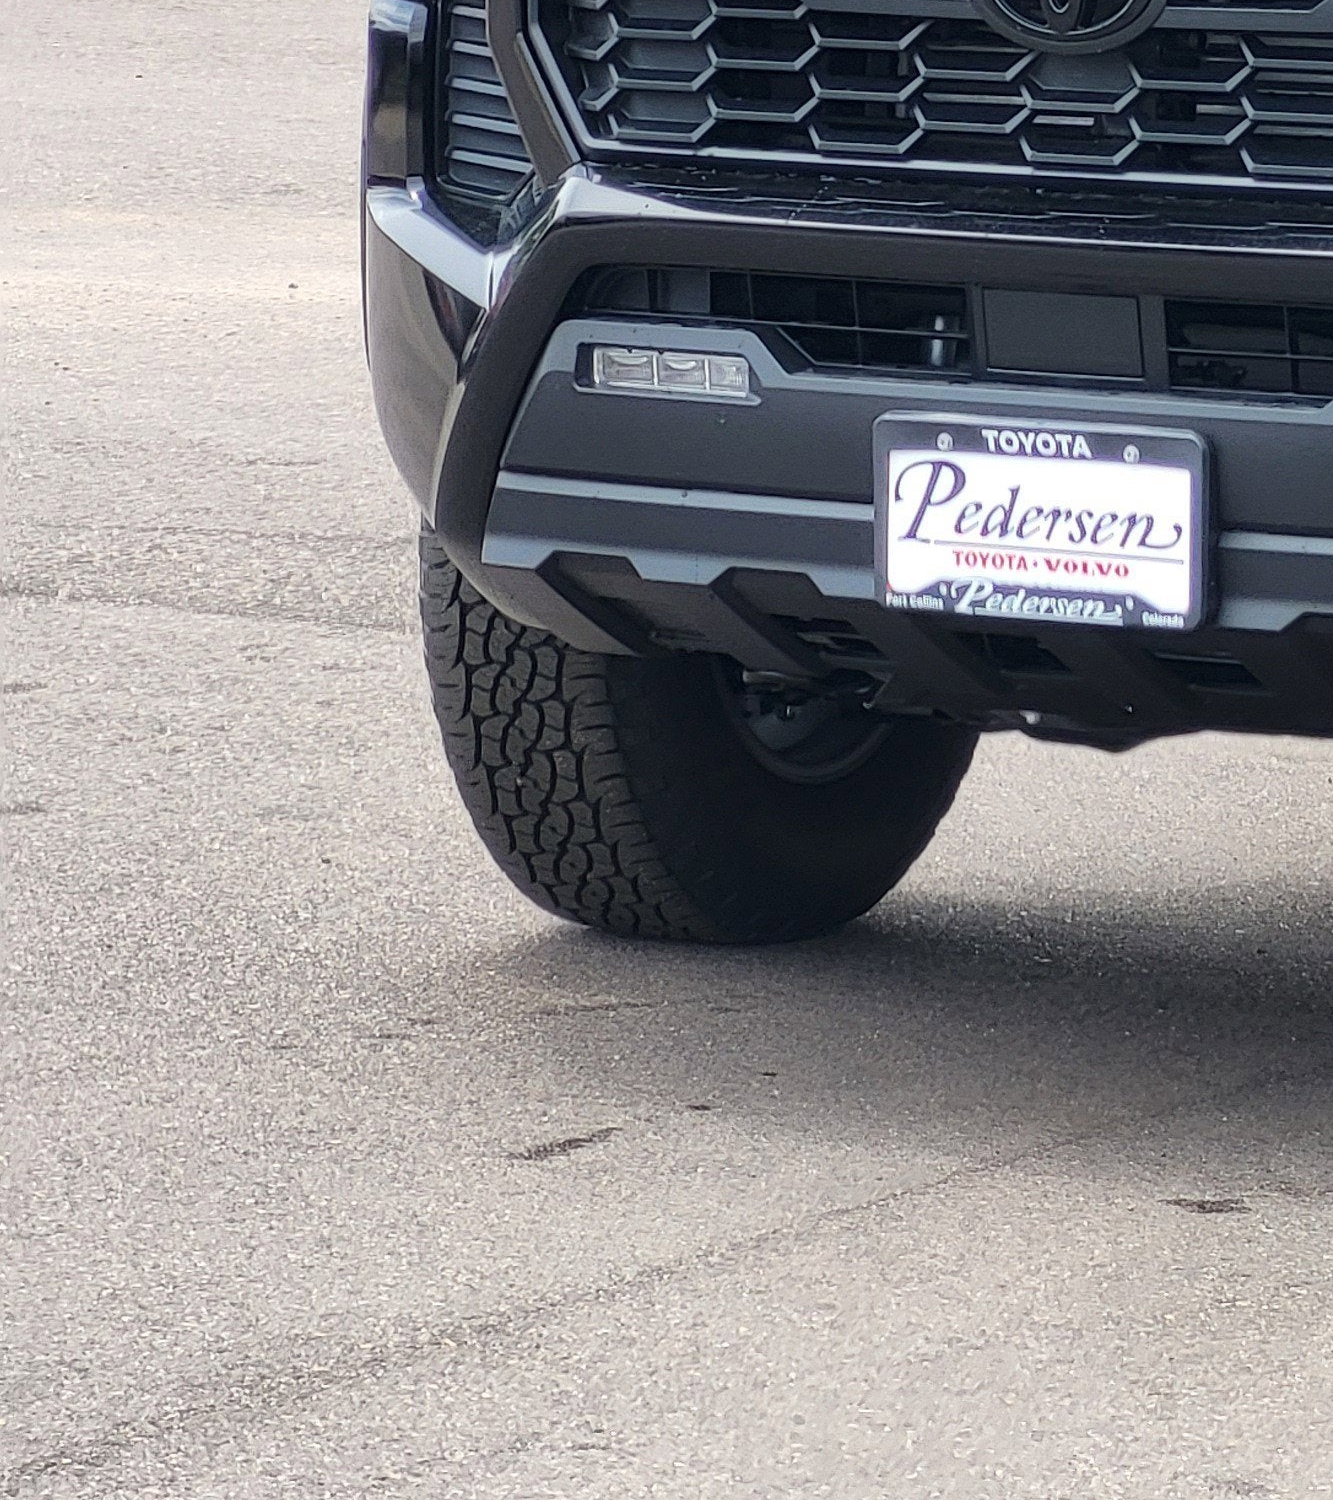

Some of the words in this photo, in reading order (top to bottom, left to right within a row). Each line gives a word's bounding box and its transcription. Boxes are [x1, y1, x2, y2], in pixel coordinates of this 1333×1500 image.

[981, 428, 1093, 460] TOYOTA
[894, 460, 1182, 549] Pedersen
[952, 550, 1029, 572] TOYOTA
[1043, 557, 1130, 578] VOLVO
[951, 578, 1123, 626] Pedersen
